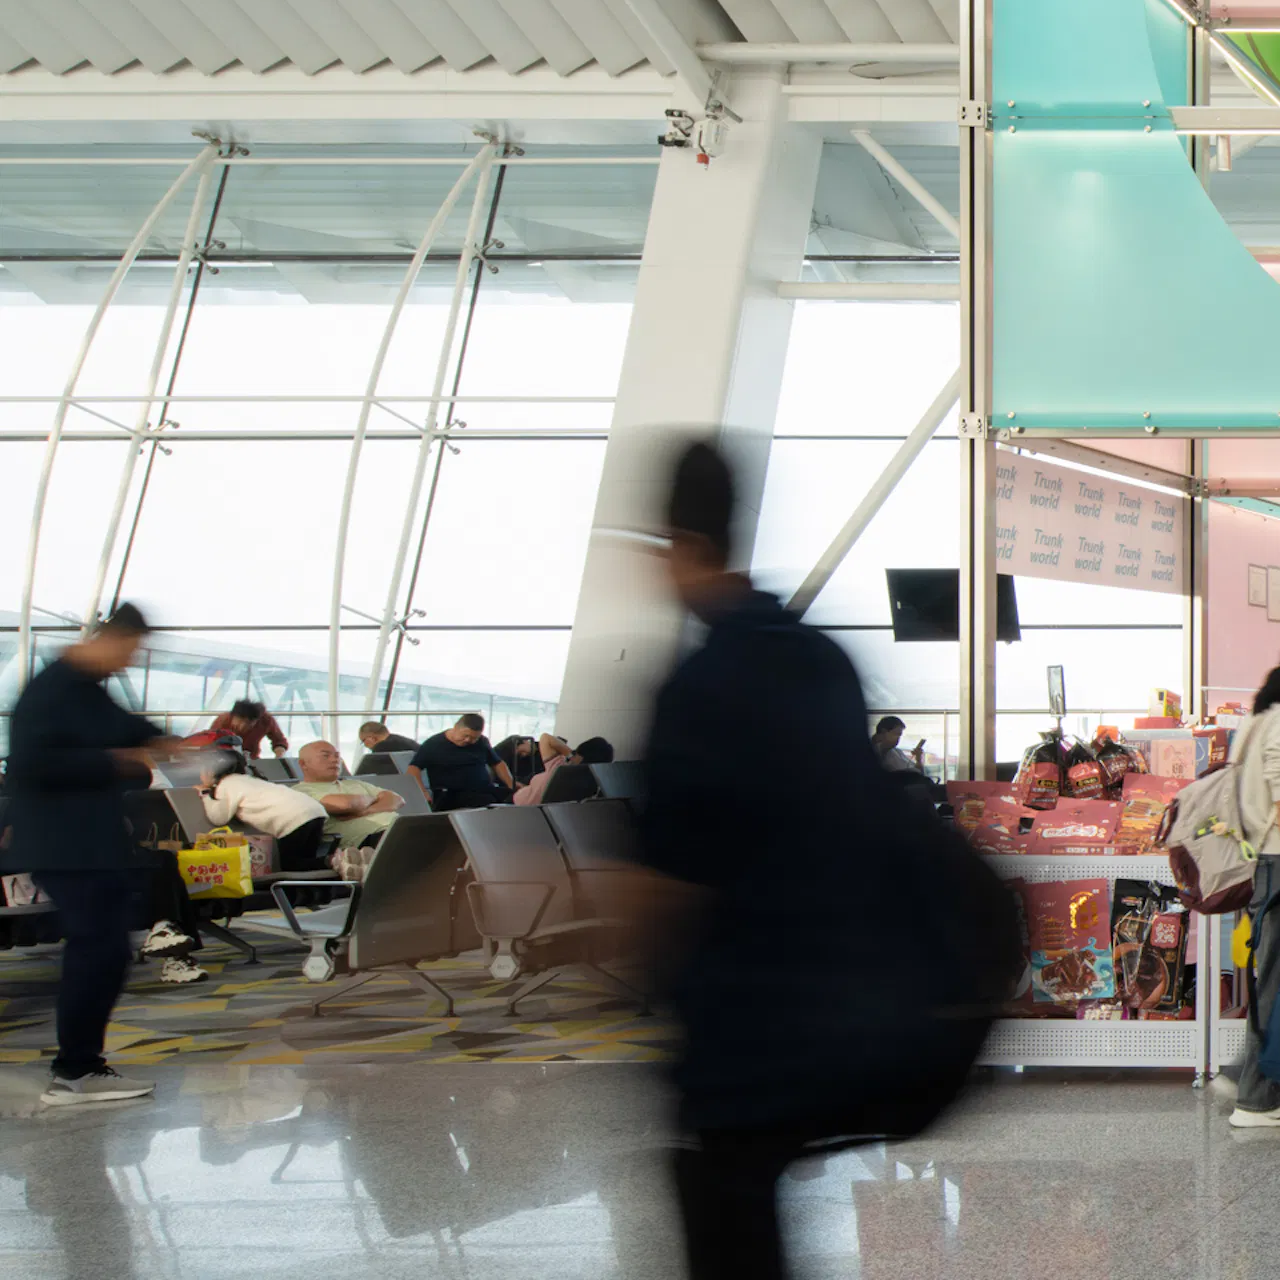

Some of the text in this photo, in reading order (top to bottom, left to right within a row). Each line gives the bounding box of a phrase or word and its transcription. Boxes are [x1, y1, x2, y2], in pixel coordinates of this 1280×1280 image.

[996, 466, 1017, 483] unk
[1033, 471, 1063, 493] Trunk
[1078, 482, 1104, 502] Trunk
[1029, 492, 1060, 510] world
[1118, 491, 1142, 511] Trunk
[1154, 500, 1176, 518] Trunk
[1074, 502, 1102, 519] world
[1114, 510, 1139, 527] world
[996, 525, 1017, 542] unk
[1151, 518, 1174, 533] world
[1034, 528, 1063, 549] Trunk
[1078, 536, 1104, 555] Trunk
[1030, 549, 1061, 566] world
[1118, 543, 1142, 561] Trunk
[1154, 550, 1176, 566] Trunk
[1074, 557, 1102, 572] world
[1114, 563, 1139, 578] world
[1151, 569, 1174, 582] world
